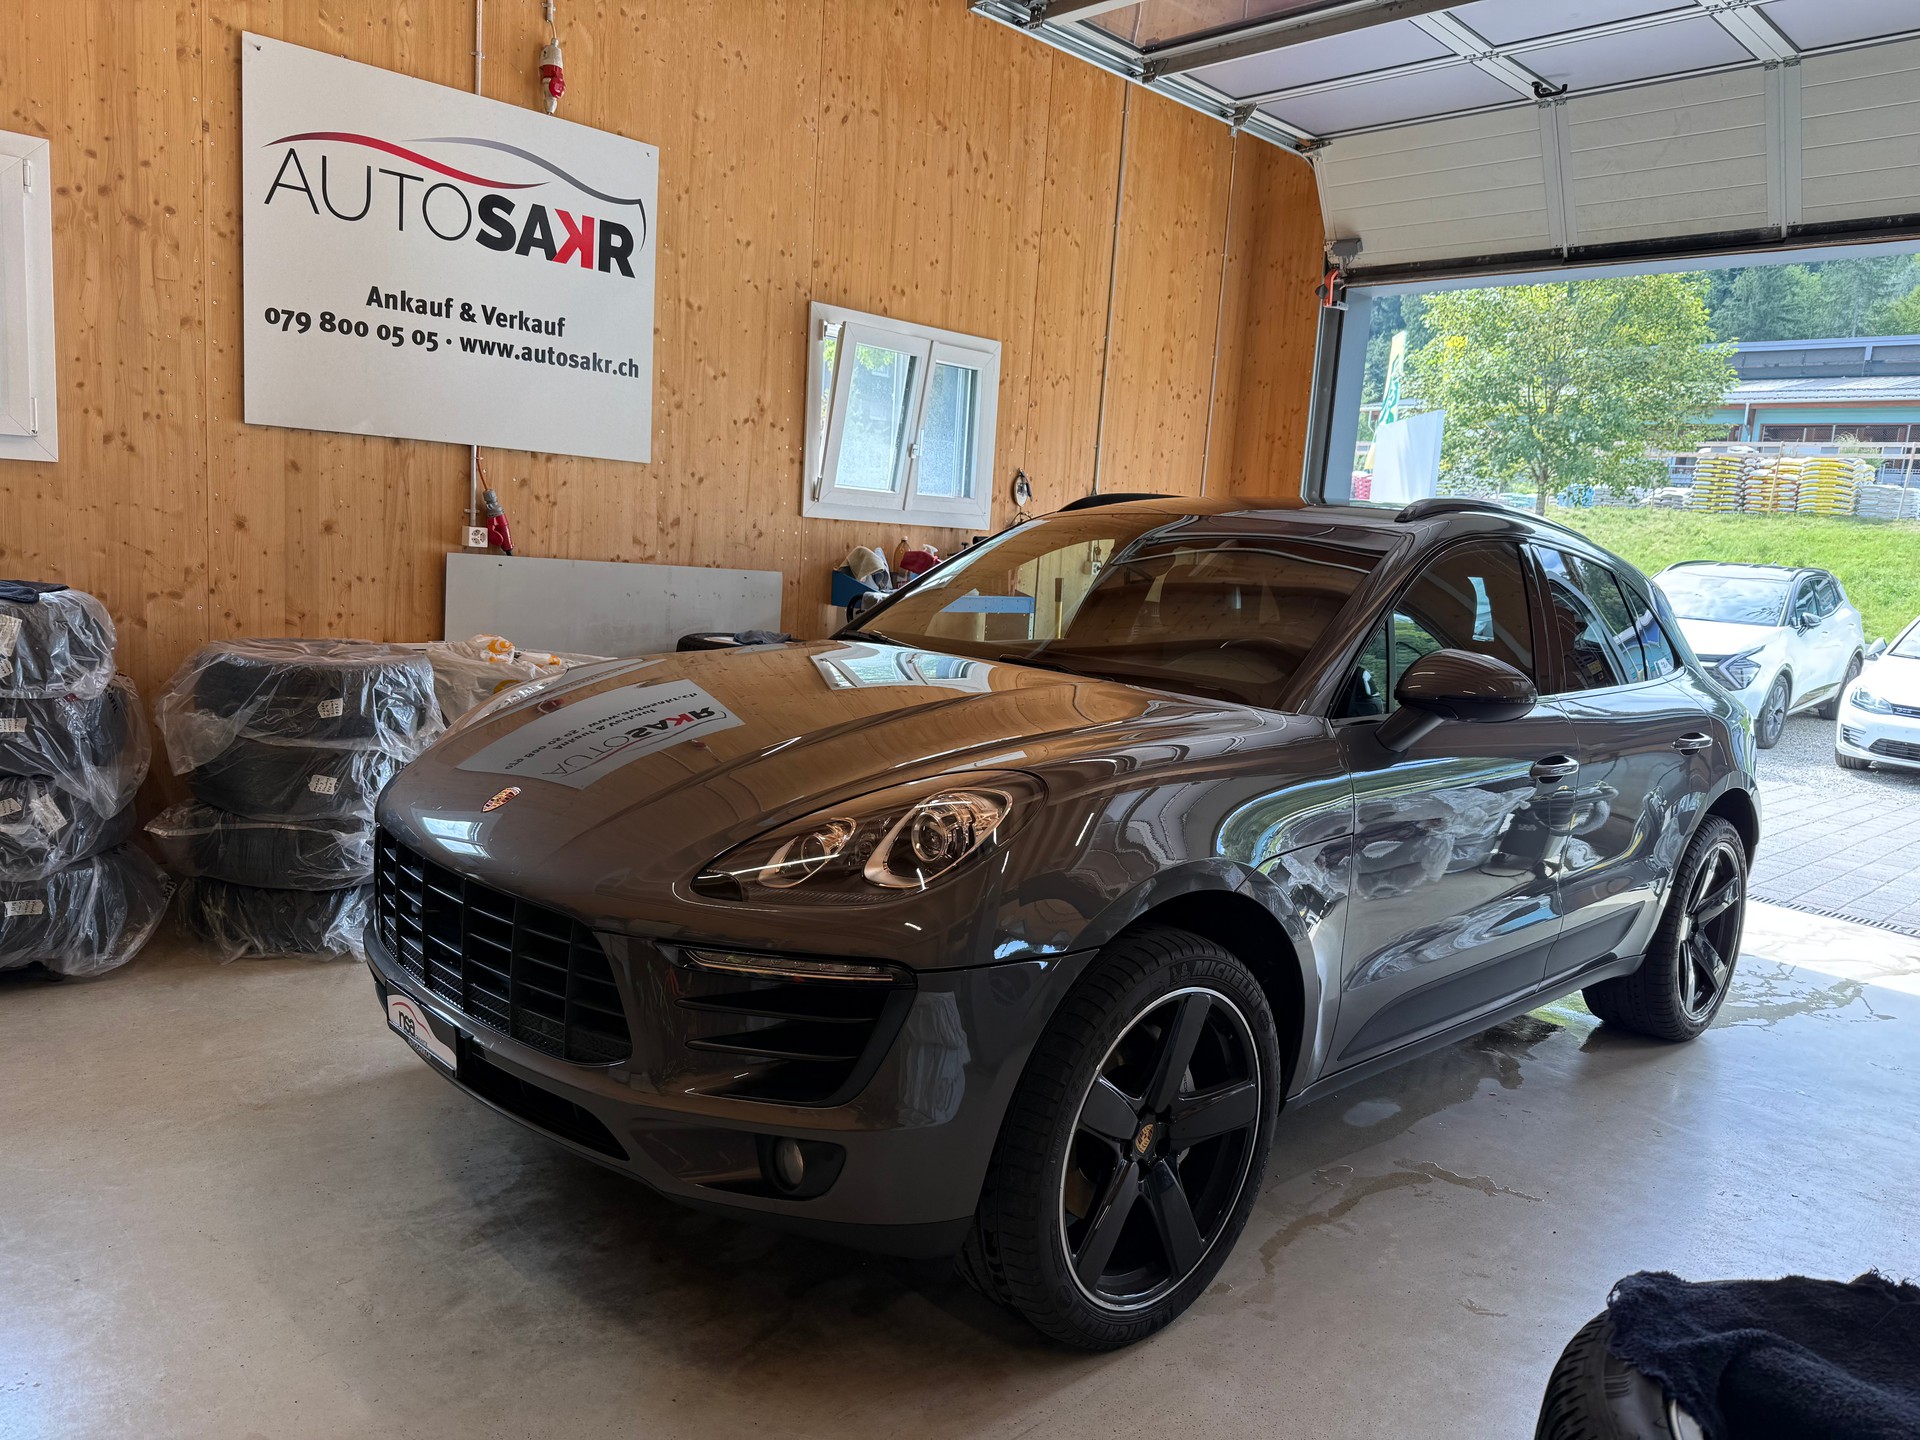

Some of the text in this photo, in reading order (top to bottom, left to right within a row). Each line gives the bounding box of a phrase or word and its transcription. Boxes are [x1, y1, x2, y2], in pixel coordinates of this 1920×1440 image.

[366, 286, 566, 337] Ankauf & Verkauf
[264, 307, 312, 334] 079
[319, 311, 370, 337] 800
[376, 324, 405, 347] 05
[411, 329, 439, 352] 05
[459, 336, 639, 378] www.autosakr.ch
[1192, 960, 1262, 1007] MICHELIN
